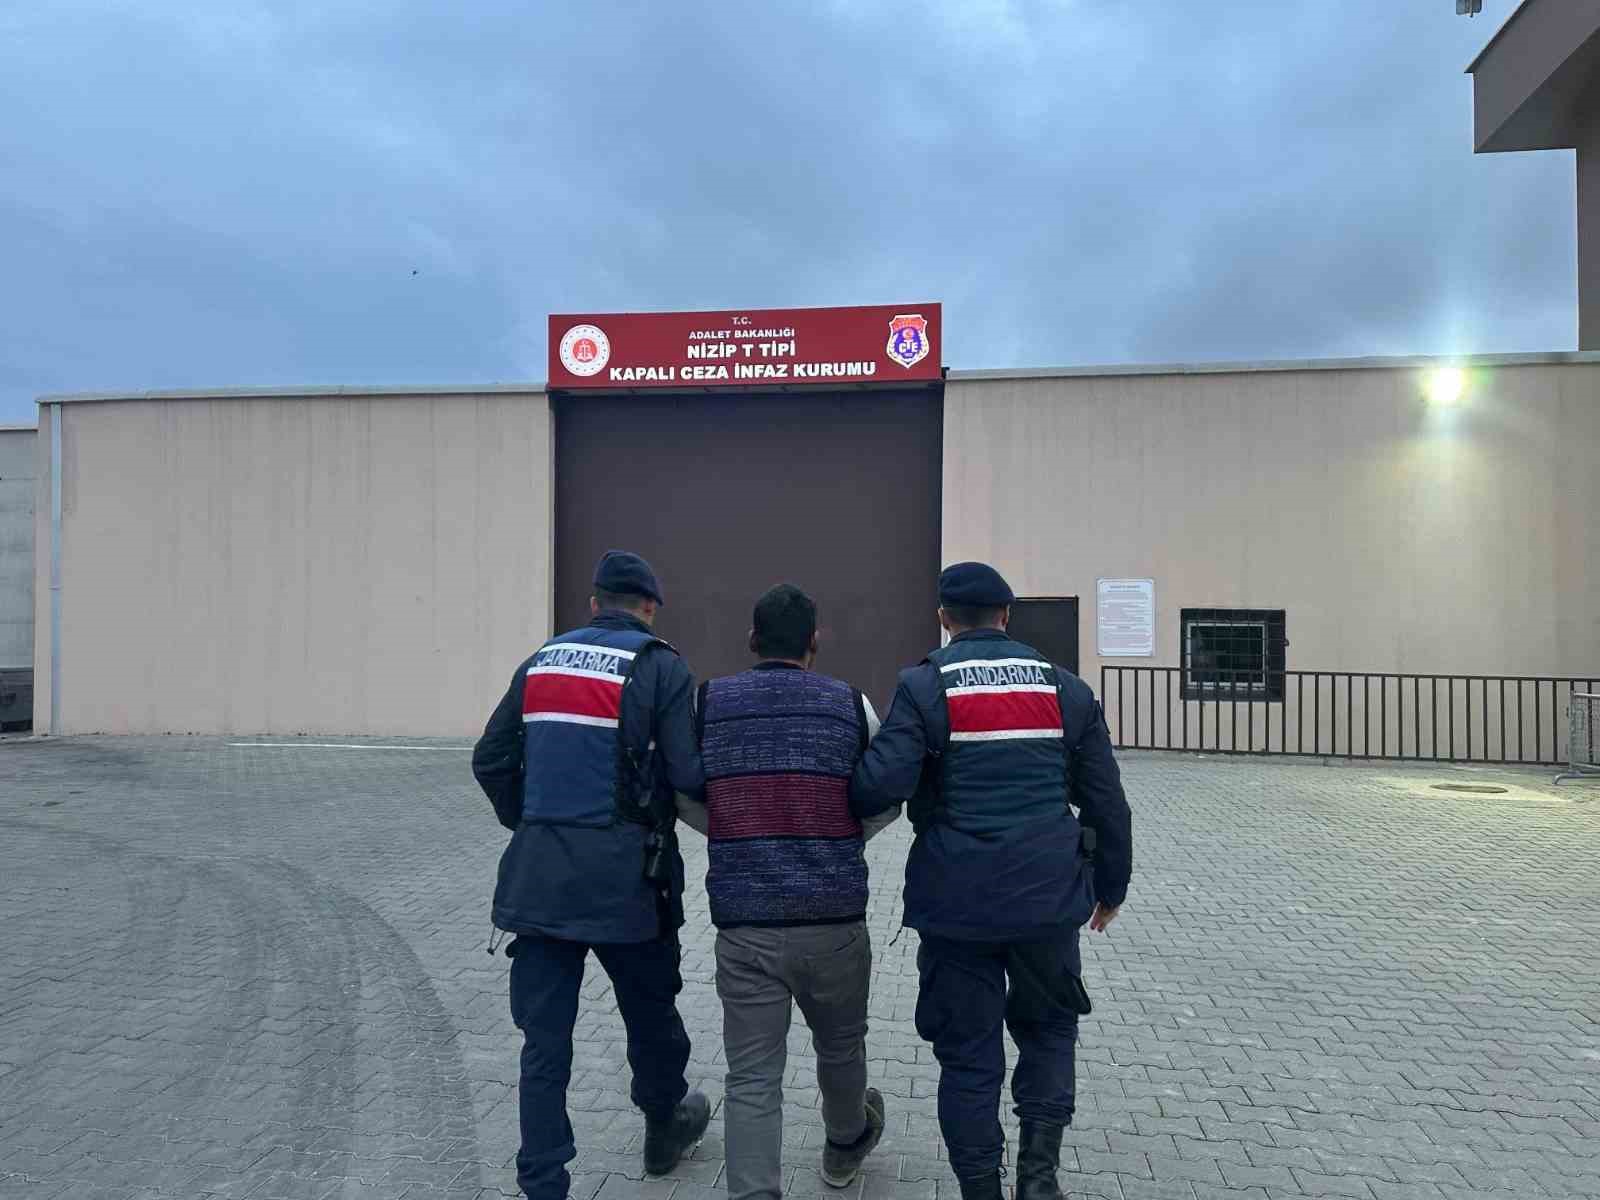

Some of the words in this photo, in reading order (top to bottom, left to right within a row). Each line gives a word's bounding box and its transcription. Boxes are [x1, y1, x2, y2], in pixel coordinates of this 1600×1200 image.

[733, 316, 752, 325] T.C.
[689, 330, 731, 339] ADALET
[734, 327, 795, 338] BAKANLIĞI
[687, 342, 737, 358] NİZİP
[742, 344, 754, 357] T
[759, 340, 796, 357] TİPİ
[609, 367, 675, 380] KAPALI
[680, 365, 729, 379] CEZA
[734, 362, 788, 378] İNFAZ
[793, 361, 876, 377] KURUMU
[536, 650, 620, 674] JANDARMA
[956, 664, 1048, 686] JANDARMA
